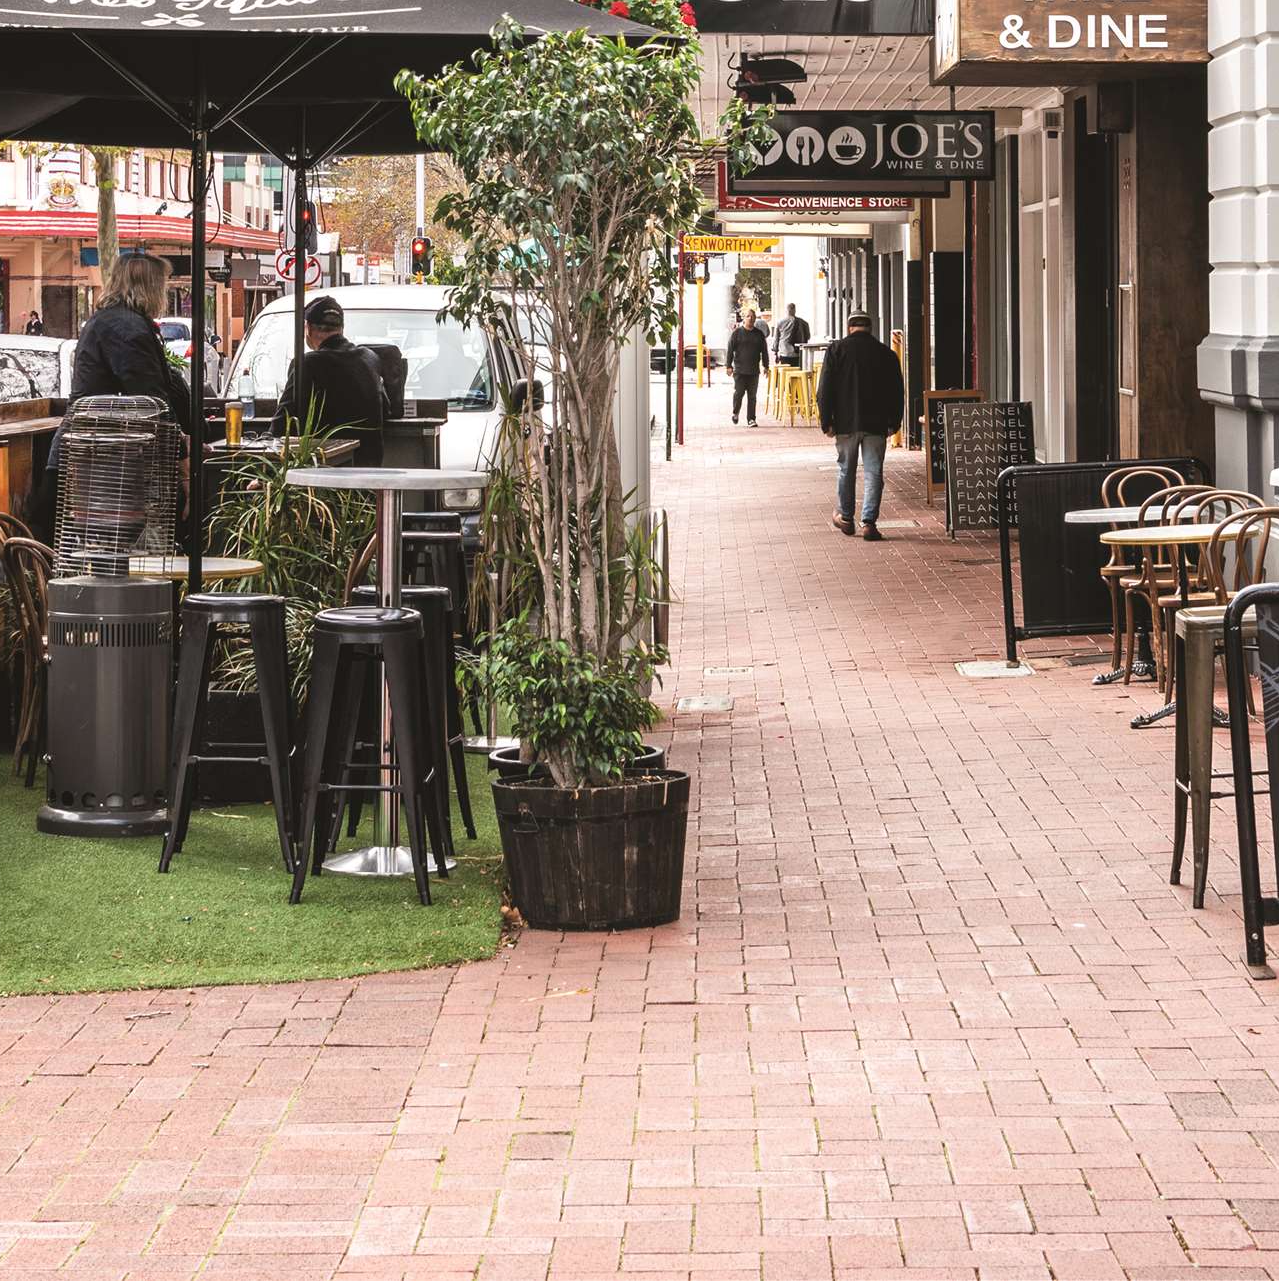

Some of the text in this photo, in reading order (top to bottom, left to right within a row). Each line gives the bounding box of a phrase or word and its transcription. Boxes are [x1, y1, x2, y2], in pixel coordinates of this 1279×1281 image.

[999, 15, 1168, 50] & DINE
[871, 120, 983, 169] JOE'S
[886, 160, 984, 169] WINE & DINE
[779, 197, 907, 208] CONVENIENCE STORE
[684, 238, 753, 252] KENWORTHY
[953, 419, 1026, 428] FLANNEL
[954, 431, 1026, 440] FLANNEL
[955, 443, 1027, 452] FLANNEL
[955, 455, 1028, 464] FLANNEL
